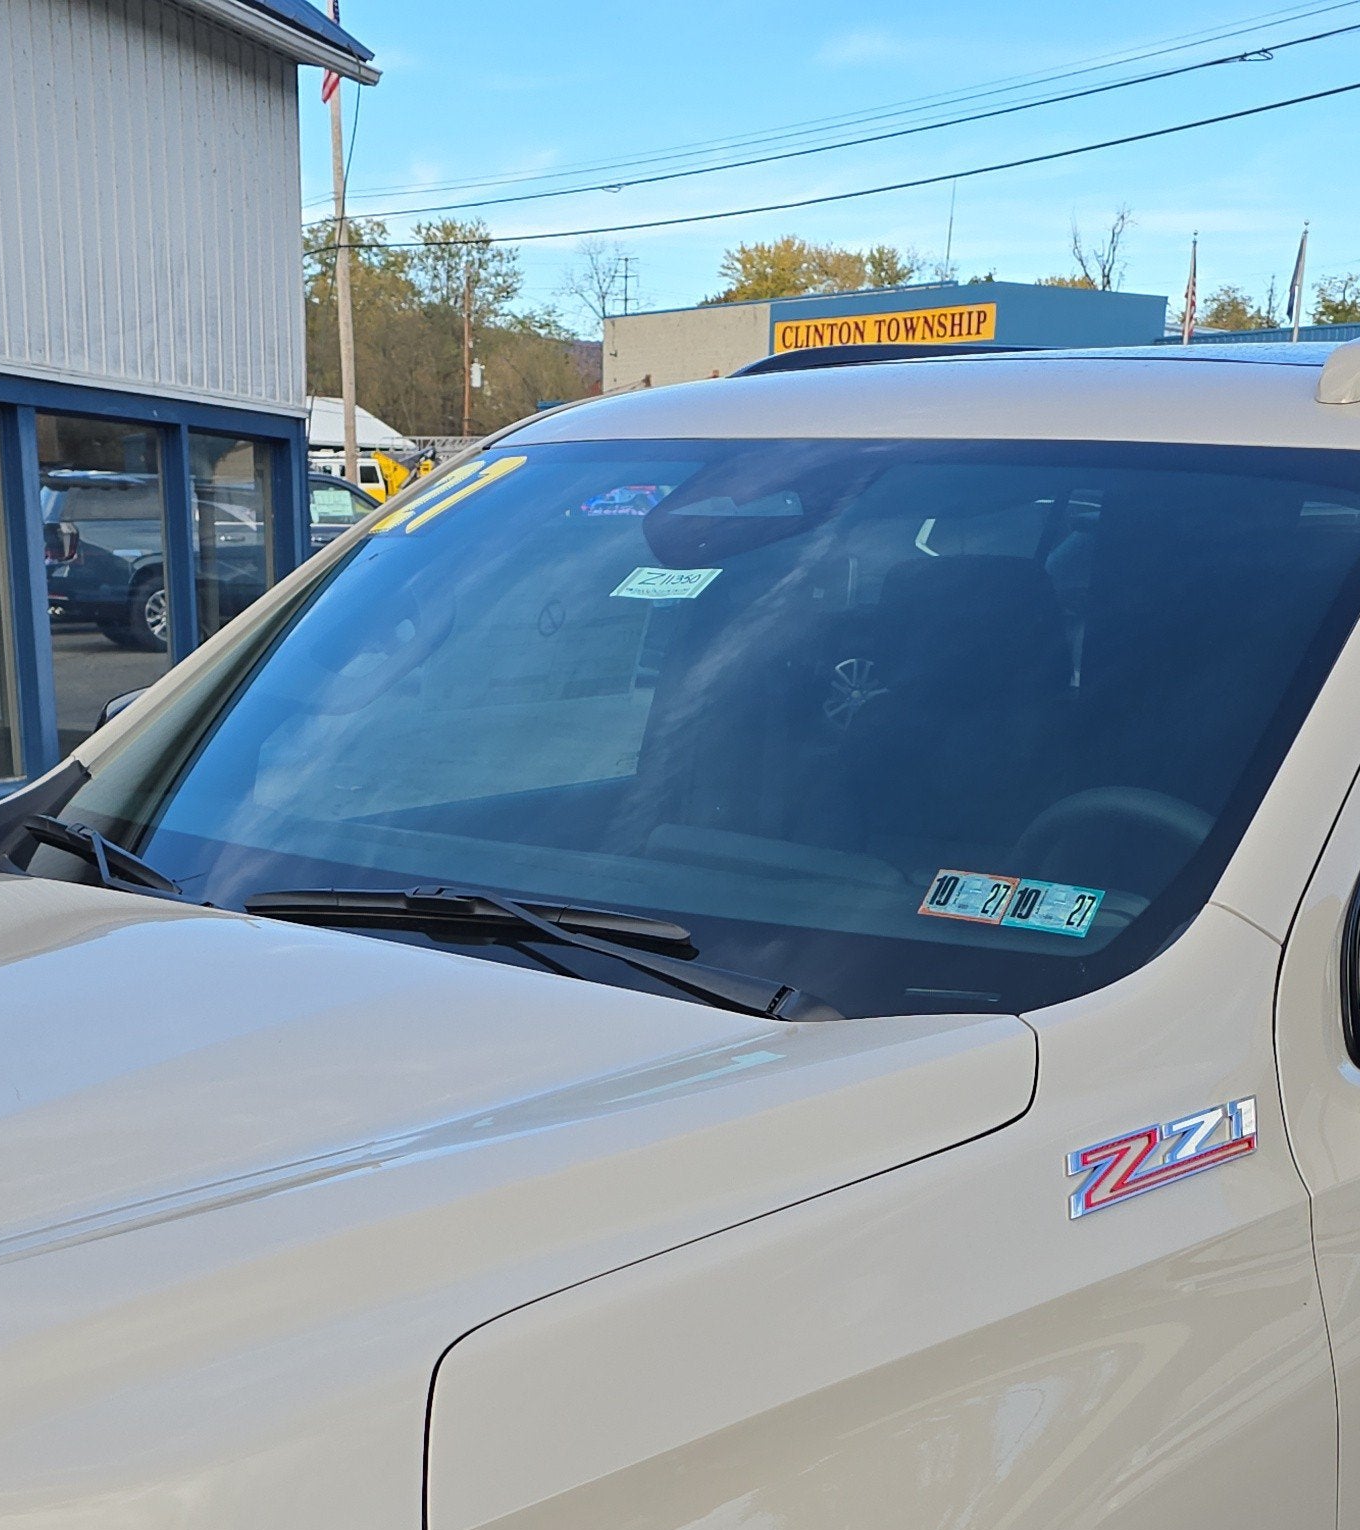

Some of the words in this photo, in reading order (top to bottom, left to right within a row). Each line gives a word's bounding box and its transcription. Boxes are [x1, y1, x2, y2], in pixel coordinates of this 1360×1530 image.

[781, 319, 867, 349] CLINTON
[874, 310, 987, 342] TOWNSHIP
[928, 875, 960, 907] 10
[981, 884, 1011, 918] 27
[1010, 887, 1041, 920] 10
[1066, 894, 1097, 928] 27
[1067, 1095, 1258, 1221] Z71
